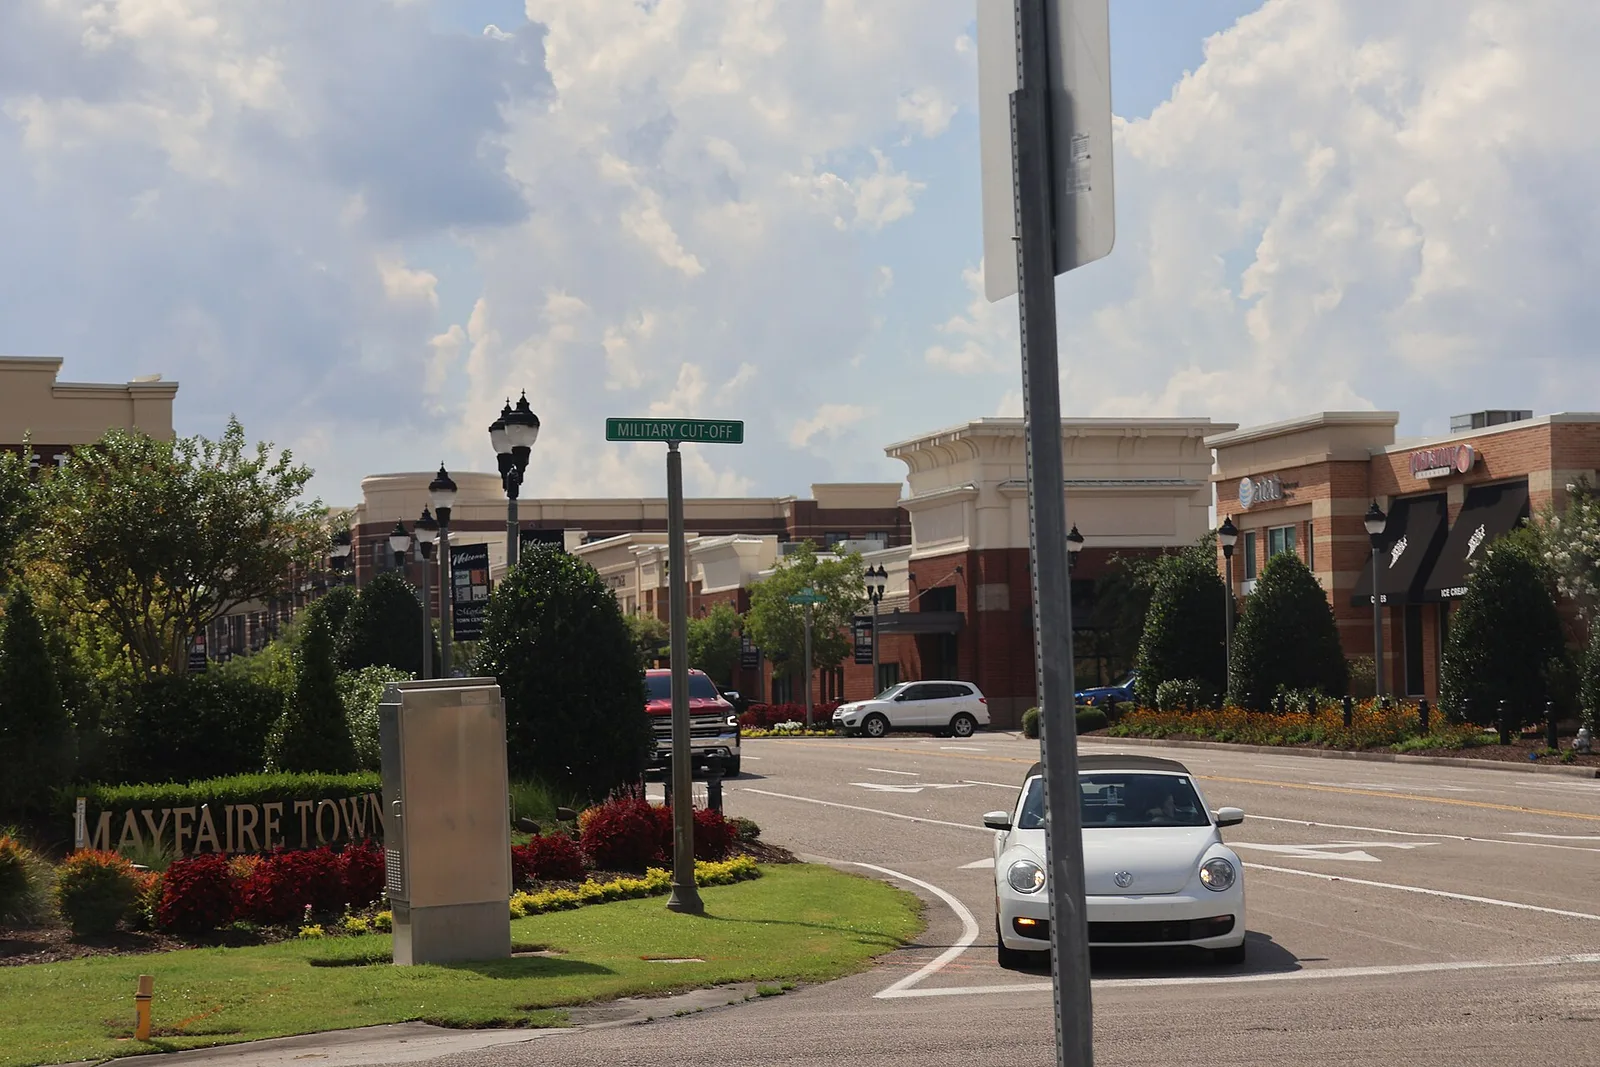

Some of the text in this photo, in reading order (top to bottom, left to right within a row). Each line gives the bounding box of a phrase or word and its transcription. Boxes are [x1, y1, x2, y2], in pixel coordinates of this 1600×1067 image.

[618, 423, 732, 439] MILITARY CUT-OFF
[452, 552, 486, 566] Welcome
[1440, 588, 1450, 598] ICE
[73, 801, 286, 857] MAYFAIRE
